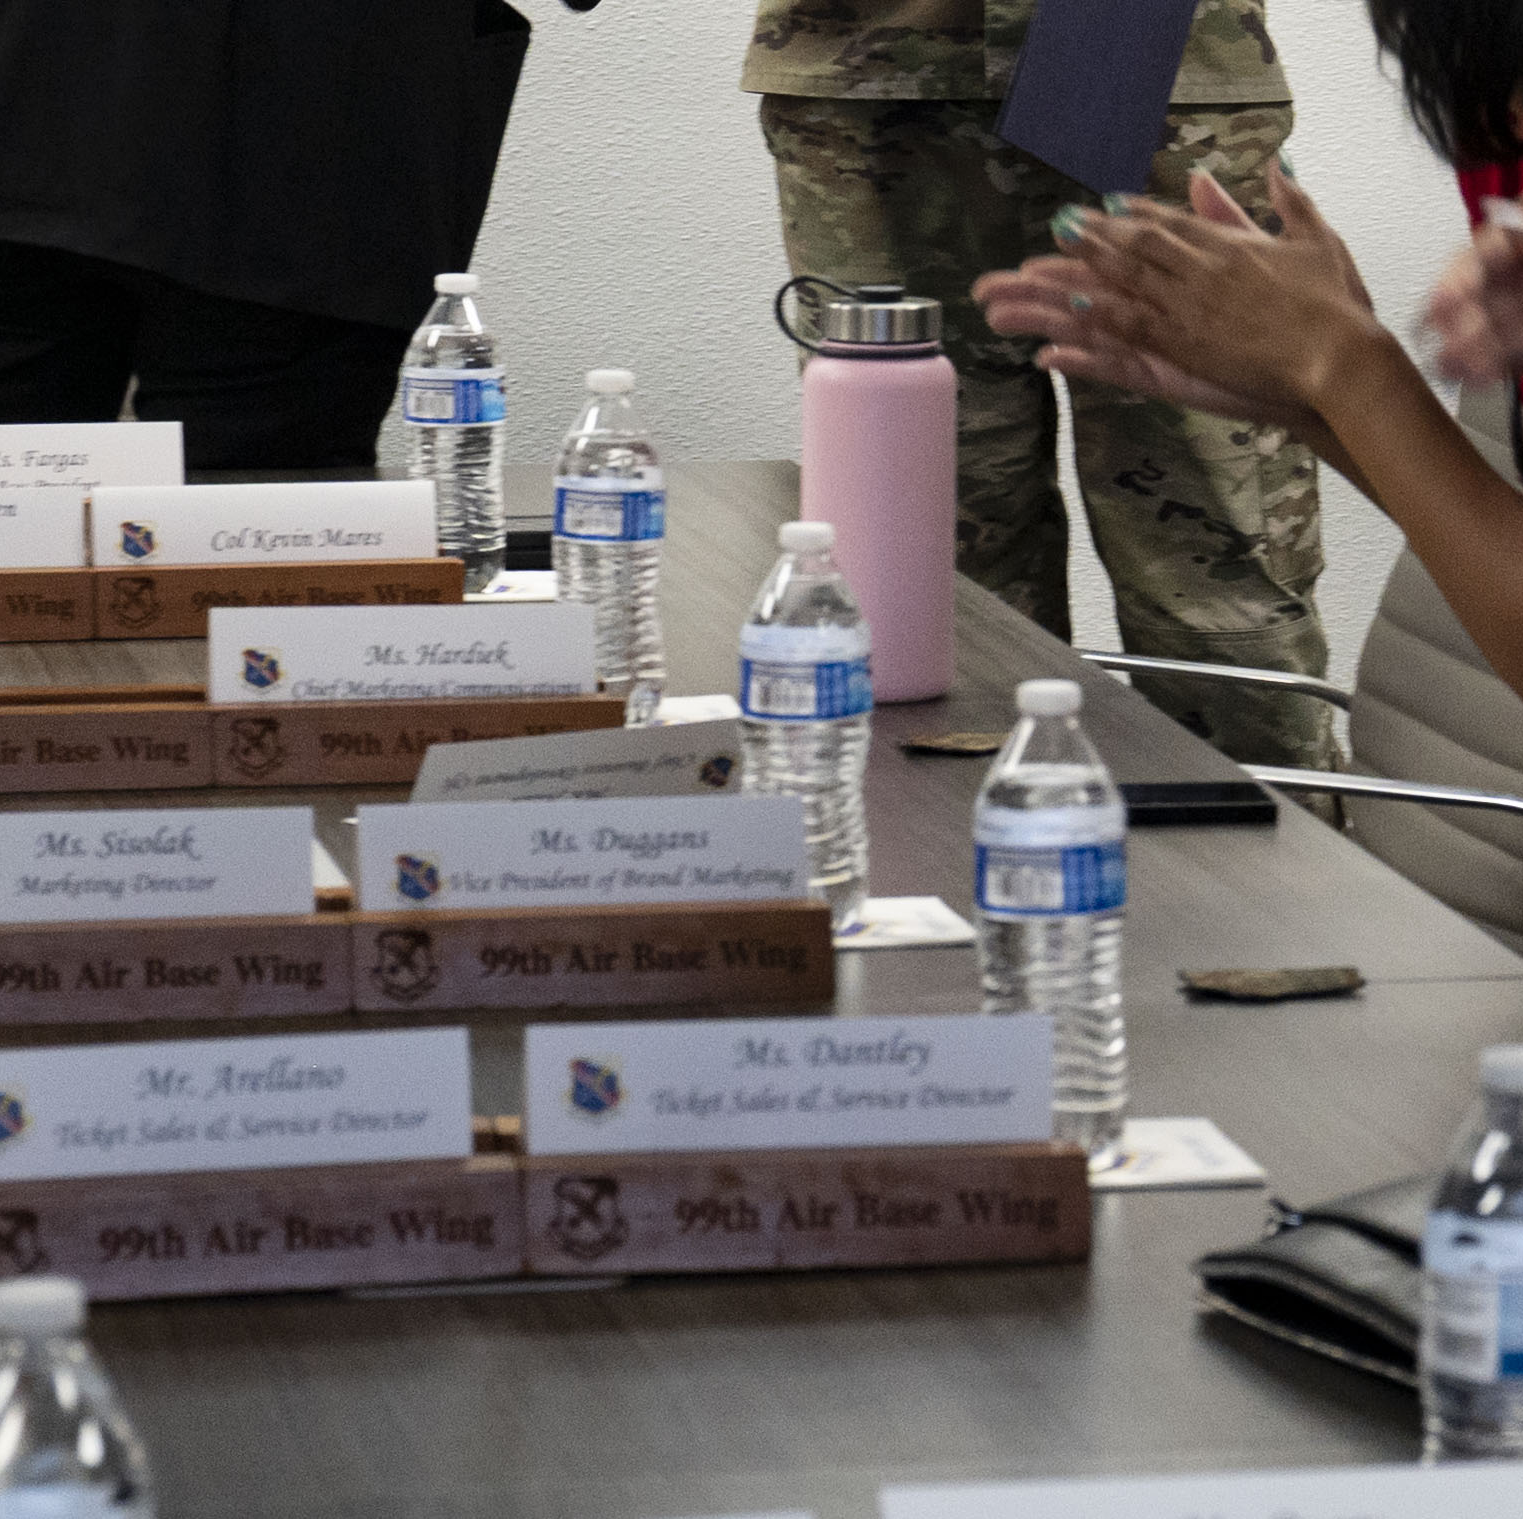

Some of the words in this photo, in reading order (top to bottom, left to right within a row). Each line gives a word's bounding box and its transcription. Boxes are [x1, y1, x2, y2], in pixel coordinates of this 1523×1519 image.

[210, 527, 250, 552] Col
[252, 527, 314, 553] Kevin
[5, 592, 78, 621] Wing
[364, 645, 408, 667] Ms.
[35, 737, 103, 765] Base
[108, 733, 191, 768] Wing
[319, 732, 383, 757] 99th
[591, 826, 710, 861] Duggans
[14, 873, 126, 900] Marketing
[131, 872, 218, 894] Director
[499, 868, 592, 892] President
[594, 867, 620, 894] of
[621, 864, 687, 888] Brand
[689, 864, 796, 891] Marketing
[79, 958, 132, 991] Air
[144, 955, 223, 990] Base
[232, 954, 324, 991] Wing
[479, 944, 553, 977] 99th
[568, 941, 616, 974] Air
[628, 940, 707, 972] Base
[720, 937, 810, 975] Wing
[802, 1029, 933, 1076] Dantley
[204, 1056, 346, 1101] Arellano
[652, 1088, 724, 1117] Ticket
[730, 1085, 790, 1114] Sales
[823, 1084, 910, 1111] Service
[916, 1081, 1017, 1109] Director
[51, 1123, 130, 1152] Ticket
[134, 1116, 198, 1145] Sales
[237, 1114, 320, 1140] Service
[323, 1107, 429, 1136] Director
[674, 1199, 760, 1235] 99th
[780, 1195, 841, 1231] Air
[854, 1193, 941, 1228] Base
[955, 1190, 1060, 1231] Wing
[96, 1222, 186, 1264] 99th
[202, 1219, 268, 1257] Air
[284, 1215, 375, 1255] Base
[389, 1209, 494, 1250] Wing
